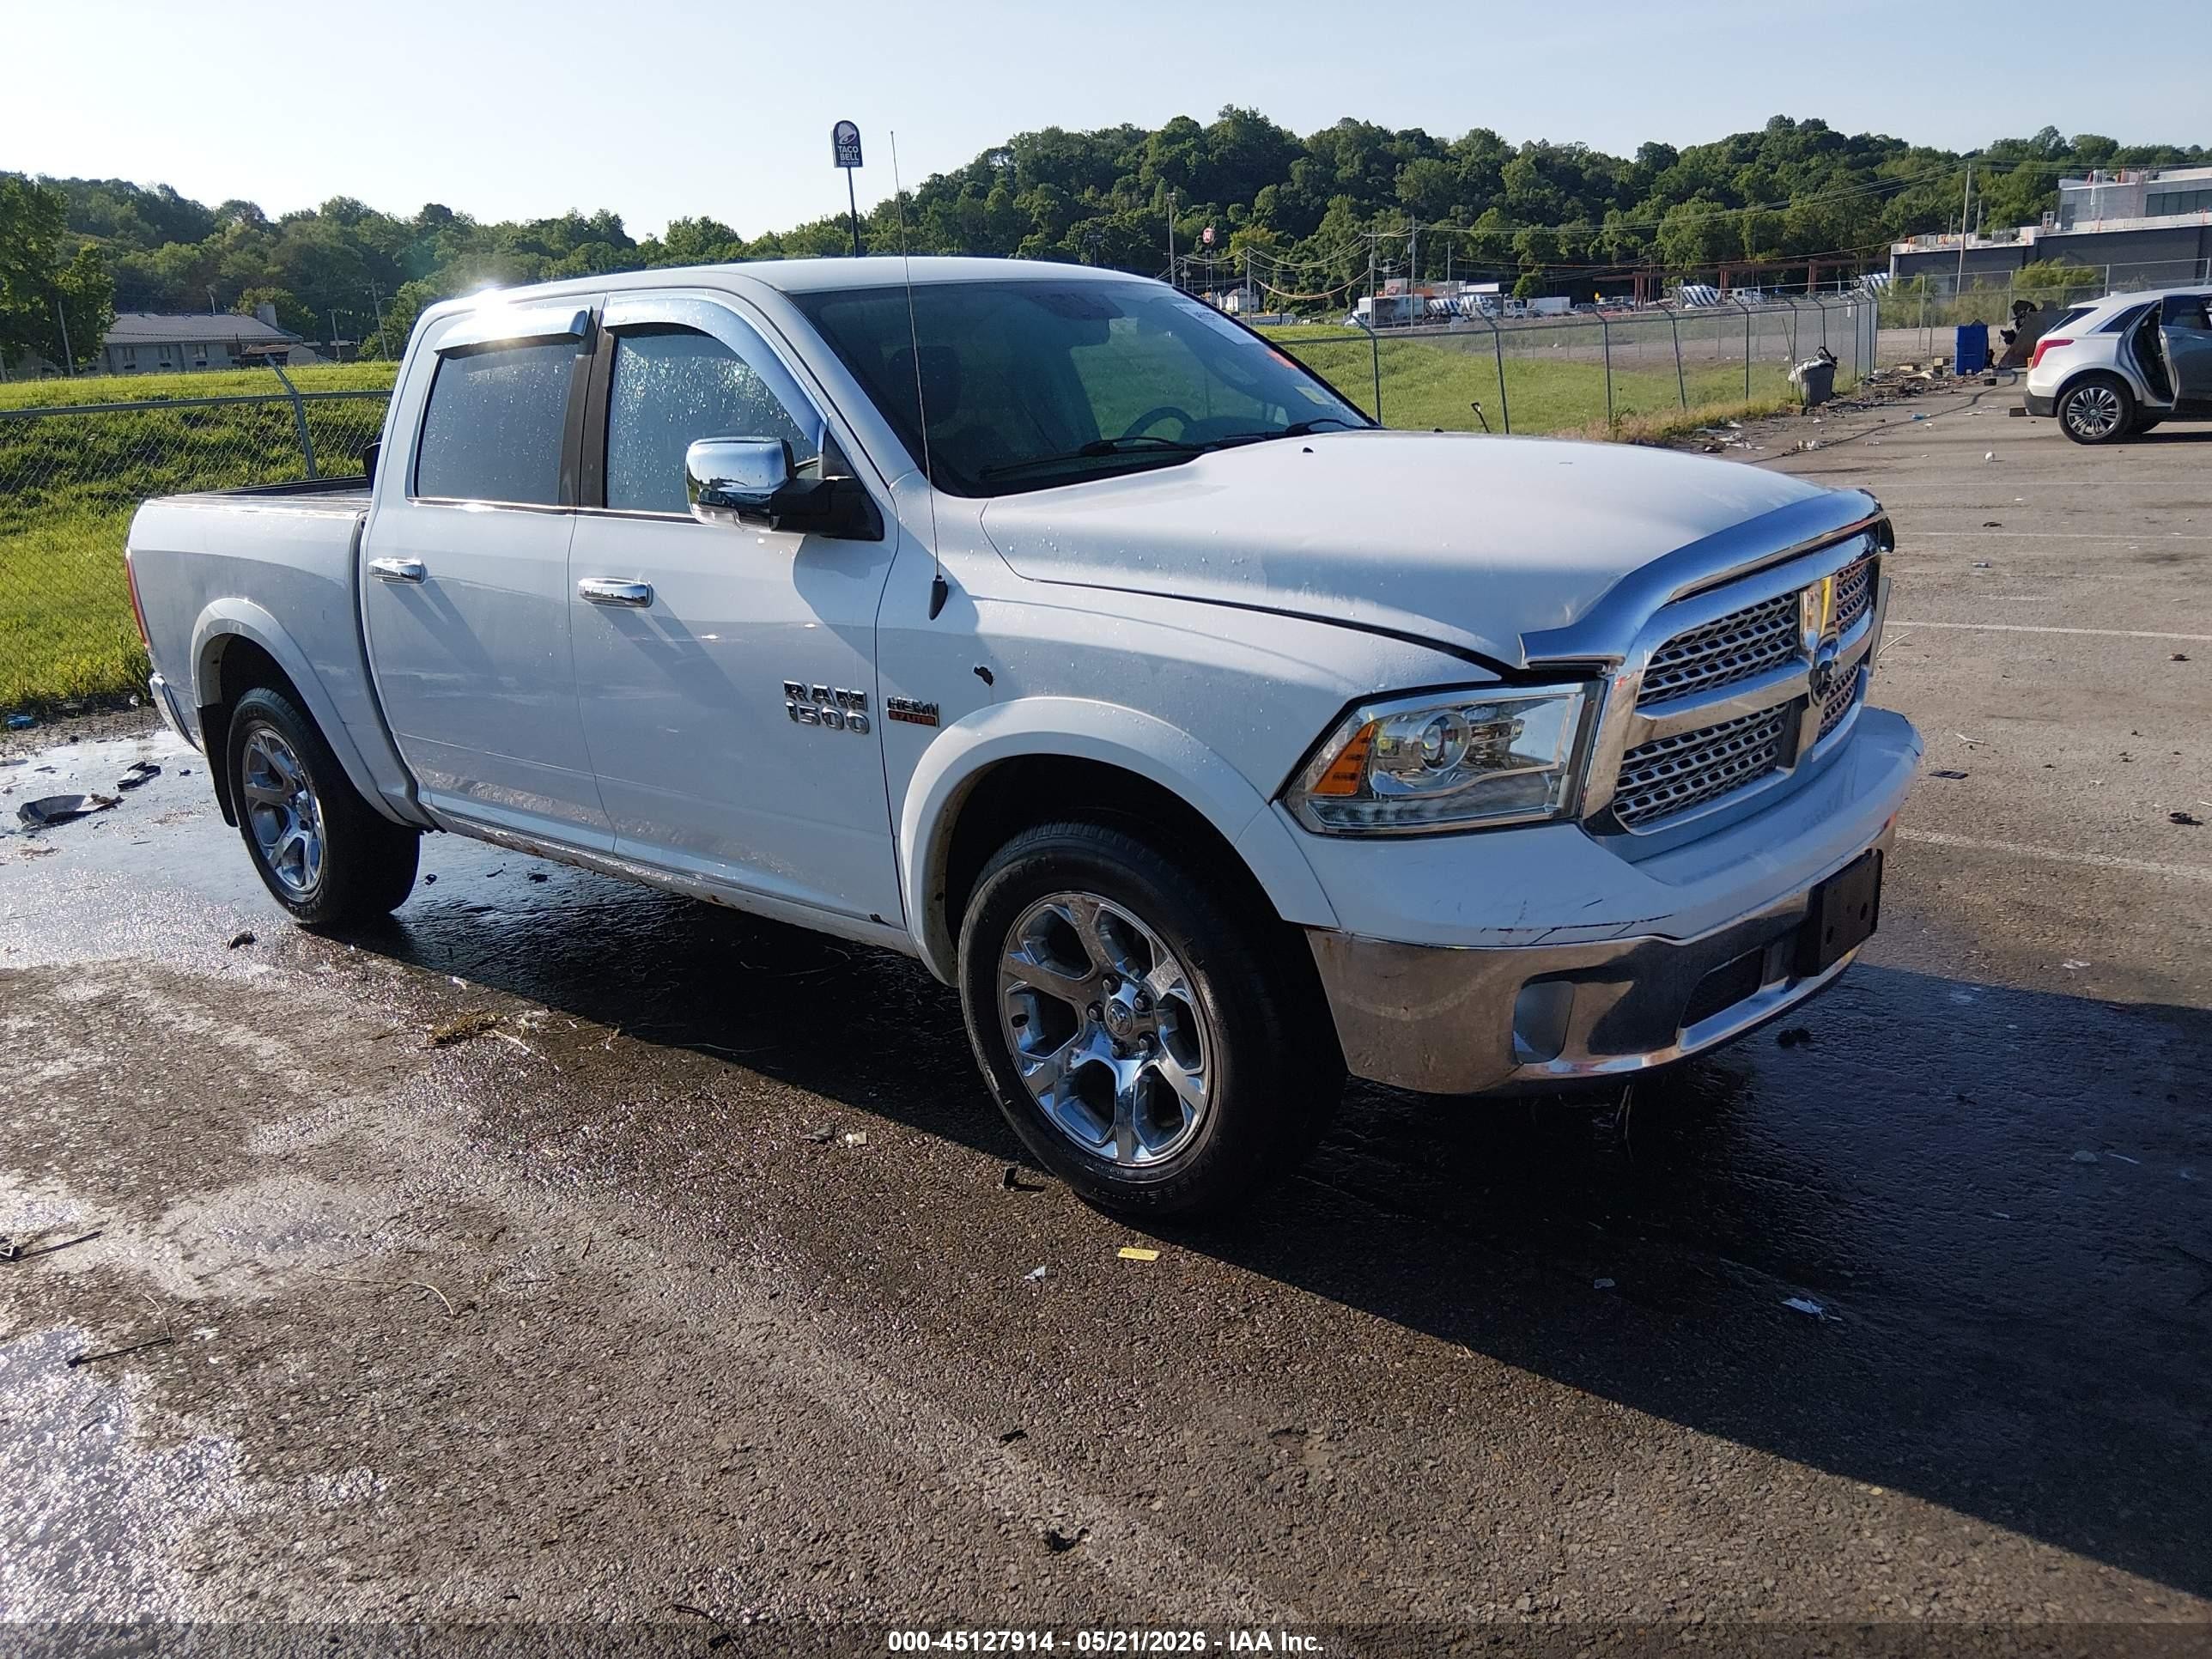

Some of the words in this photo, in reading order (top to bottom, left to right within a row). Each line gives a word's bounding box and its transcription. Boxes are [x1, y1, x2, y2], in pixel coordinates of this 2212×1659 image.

[783, 680, 869, 712] RAM
[887, 696, 939, 720] HEMI
[786, 702, 870, 735] 1500
